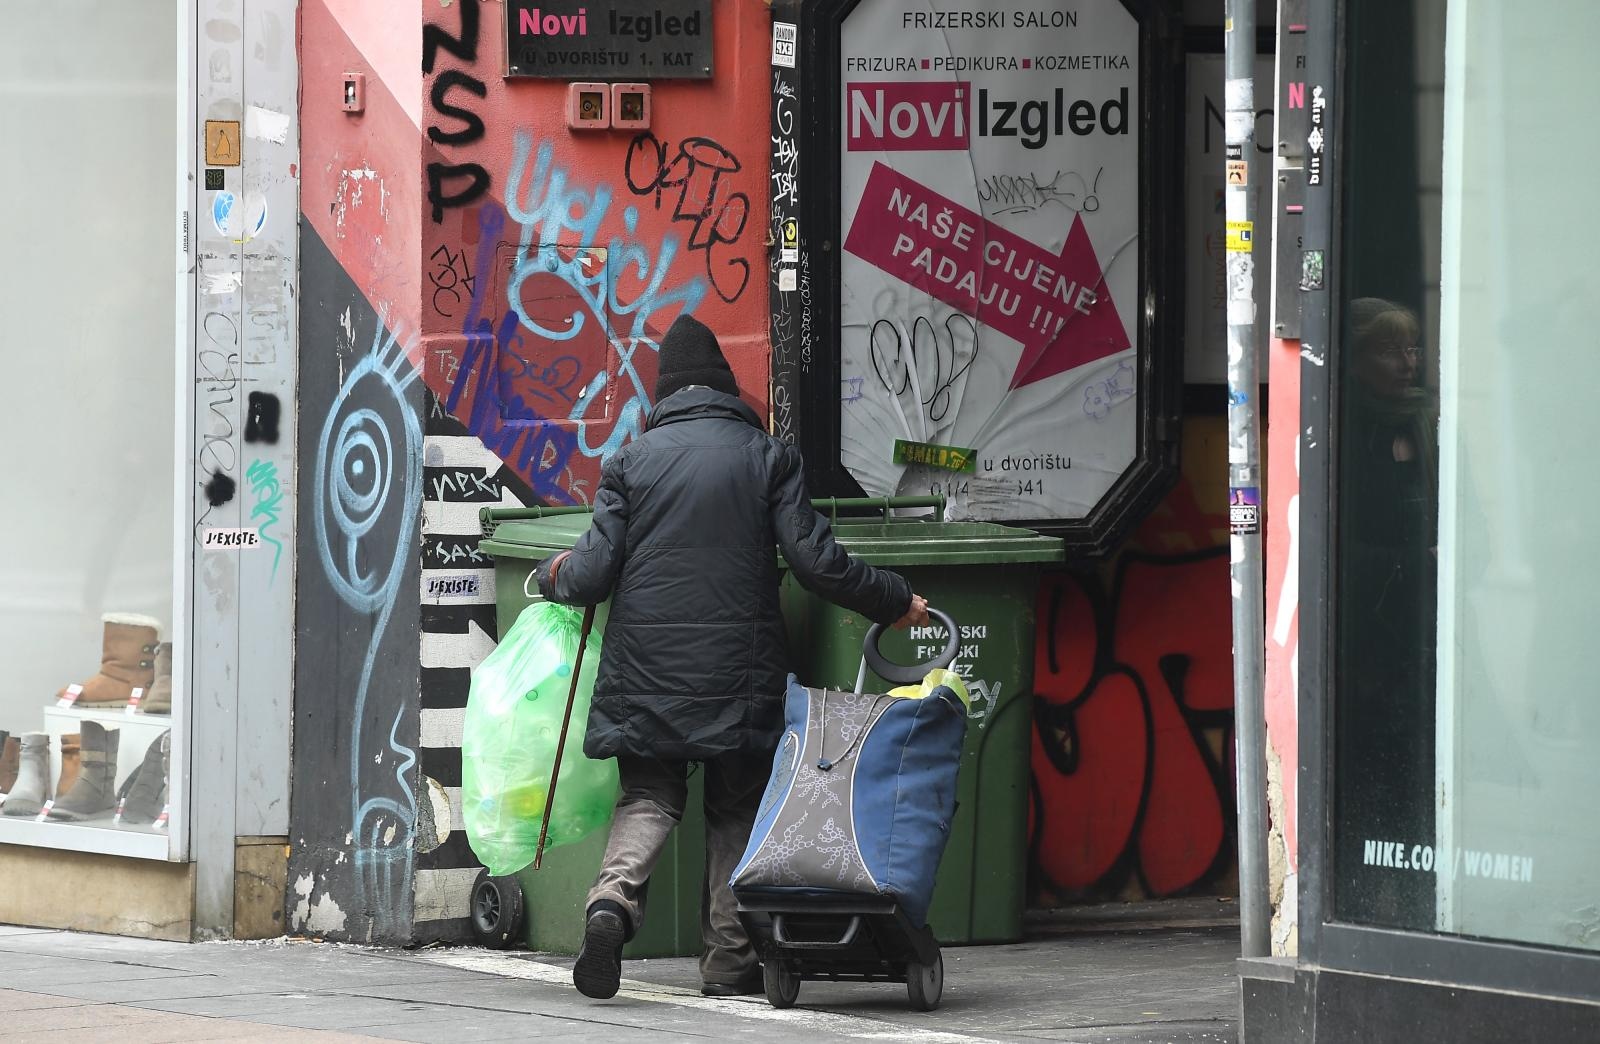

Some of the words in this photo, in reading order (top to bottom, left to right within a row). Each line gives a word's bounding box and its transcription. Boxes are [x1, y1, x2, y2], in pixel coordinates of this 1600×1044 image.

[519, 8, 588, 36] Novi
[609, 9, 701, 43] Izgled
[903, 11, 1005, 29] FRIZERSKI
[1013, 10, 1078, 28] SALON
[525, 51, 536, 65] U
[546, 47, 629, 66] DVORIŠTU
[639, 52, 653, 66] 1.
[663, 52, 694, 66] KAT
[847, 57, 917, 72] FRIZURA
[934, 56, 1019, 71] PEDIKURA
[1035, 55, 1130, 71] KOZMETIKA
[851, 88, 965, 139] Novi
[978, 87, 1129, 150] Izgled
[887, 187, 975, 251] NAŠE
[983, 239, 1097, 315] CIJENE
[891, 232, 1021, 317] PADAJU
[984, 459, 993, 472] u
[1001, 453, 1071, 471] dvorištu
[206, 532, 258, 545] J'EXISTE.
[429, 579, 478, 594] J'EXISTE.
